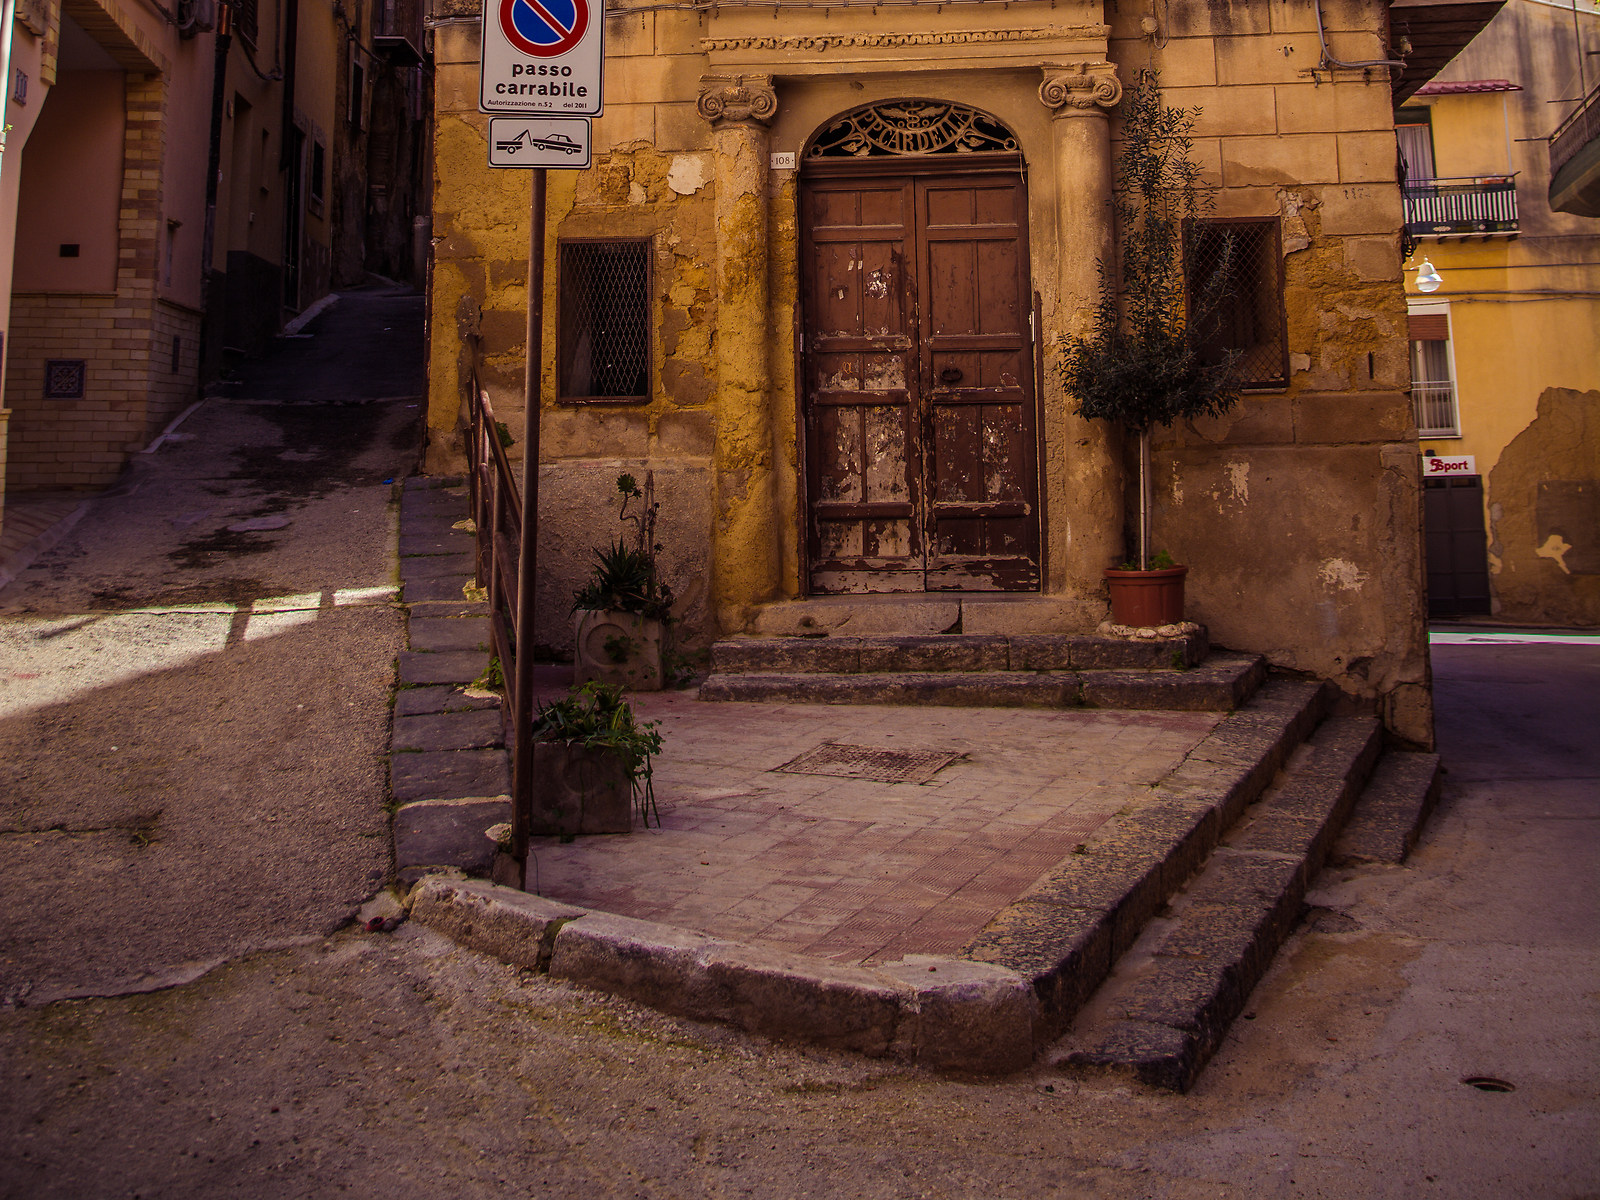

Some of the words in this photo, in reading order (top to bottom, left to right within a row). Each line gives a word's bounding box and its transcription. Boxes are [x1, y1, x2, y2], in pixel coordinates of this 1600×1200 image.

[512, 63, 573, 78] passo
[495, 81, 588, 98] carrabile
[487, 99, 536, 108] Autorizzazione
[562, 101, 574, 109] del
[775, 156, 790, 165] 108
